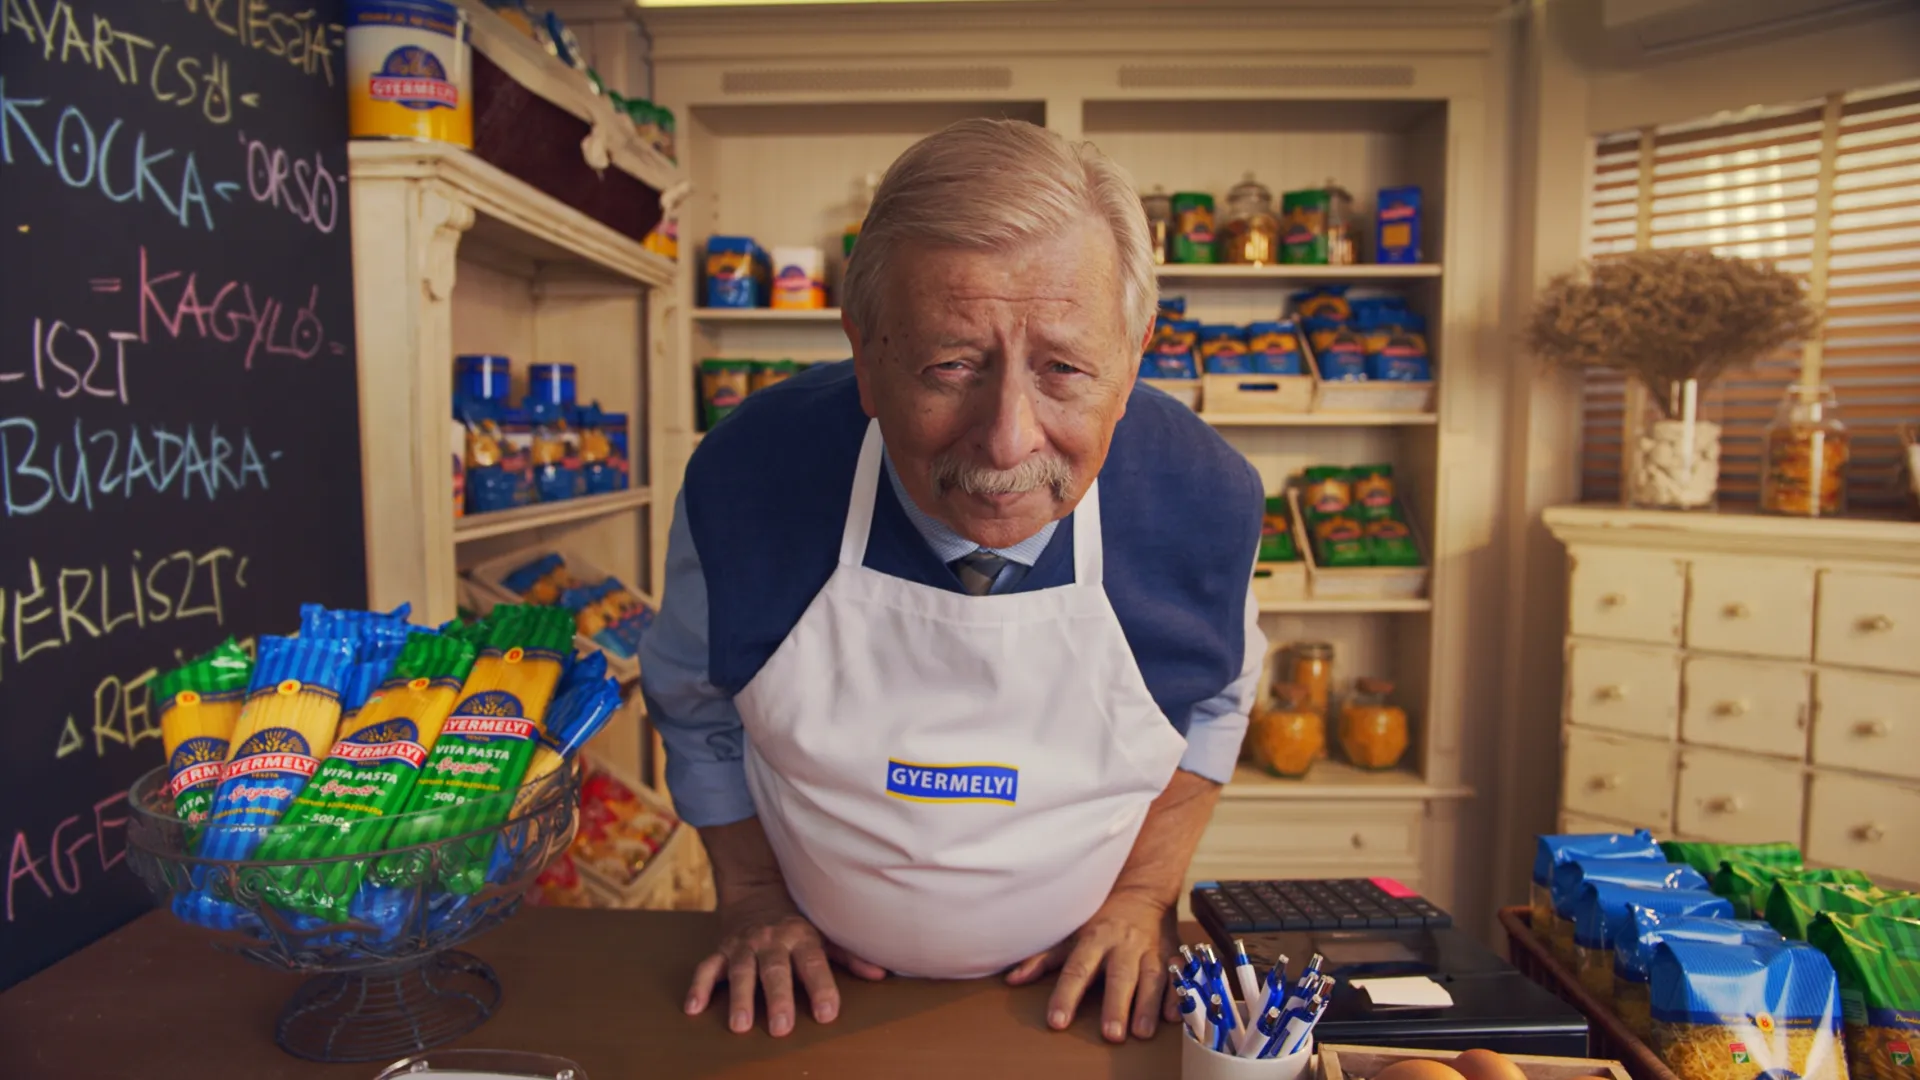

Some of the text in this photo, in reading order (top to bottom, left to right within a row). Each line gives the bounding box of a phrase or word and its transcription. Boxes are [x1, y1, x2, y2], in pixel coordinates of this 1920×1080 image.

[0, 76, 215, 231] KOCKA
[140, 245, 323, 370] KAGYLÓ
[0, 547, 233, 674] ÉRLISZT
[435, 744, 510, 760] VITA PASTA
[322, 767, 398, 784] VITA PASTA
[891, 767, 1014, 796] GYERMELYI
[176, 795, 205, 819] VITA
[432, 791, 456, 802] 500
[311, 812, 335, 824] 500
